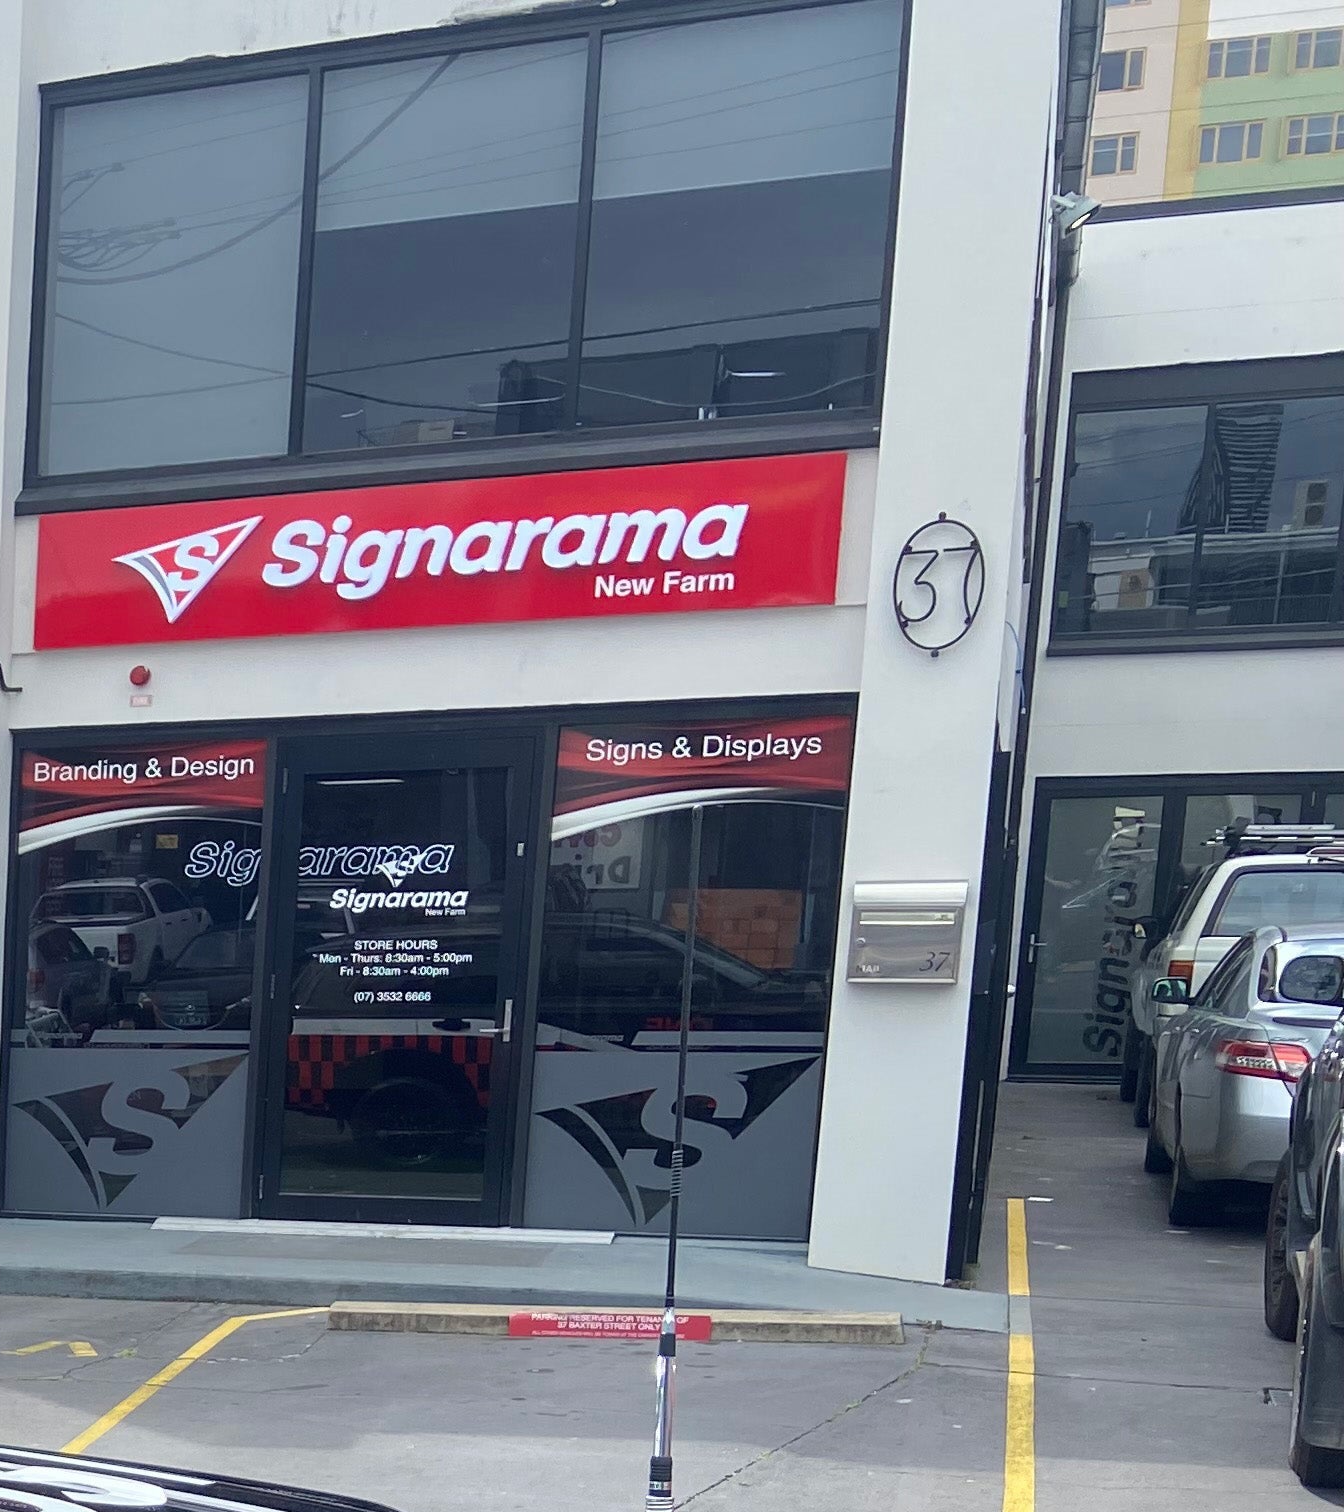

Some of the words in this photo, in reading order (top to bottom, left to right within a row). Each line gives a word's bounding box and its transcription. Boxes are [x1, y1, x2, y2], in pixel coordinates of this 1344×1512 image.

[262, 502, 750, 601] Signarama
[594, 574, 653, 599] New
[662, 570, 735, 596] Farm
[895, 542, 985, 626] 37
[585, 737, 663, 766] Signs
[672, 736, 692, 758] &
[702, 733, 823, 762] Displays
[33, 758, 138, 784] Branding
[144, 758, 162, 778] &
[171, 754, 255, 780] Design
[329, 887, 469, 913] Signarama
[425, 908, 443, 917] New
[444, 907, 466, 916] Farm
[354, 940, 394, 950] STORE
[396, 939, 439, 950] HOURS
[319, 953, 342, 963] Mon
[384, 953, 424, 963] 8:30am
[433, 952, 473, 965] 5:00pm
[918, 951, 951, 972] 37
[339, 966, 354, 976] Fri
[362, 966, 401, 976] 8:30am
[410, 966, 450, 978] 4:00pm
[353, 992, 375, 1003] (07)
[376, 992, 403, 1001] 3532
[569, 1321, 603, 1330] BAXTER
[603, 1322, 636, 1330] STREET
[616, 1315, 634, 1323] FOR
